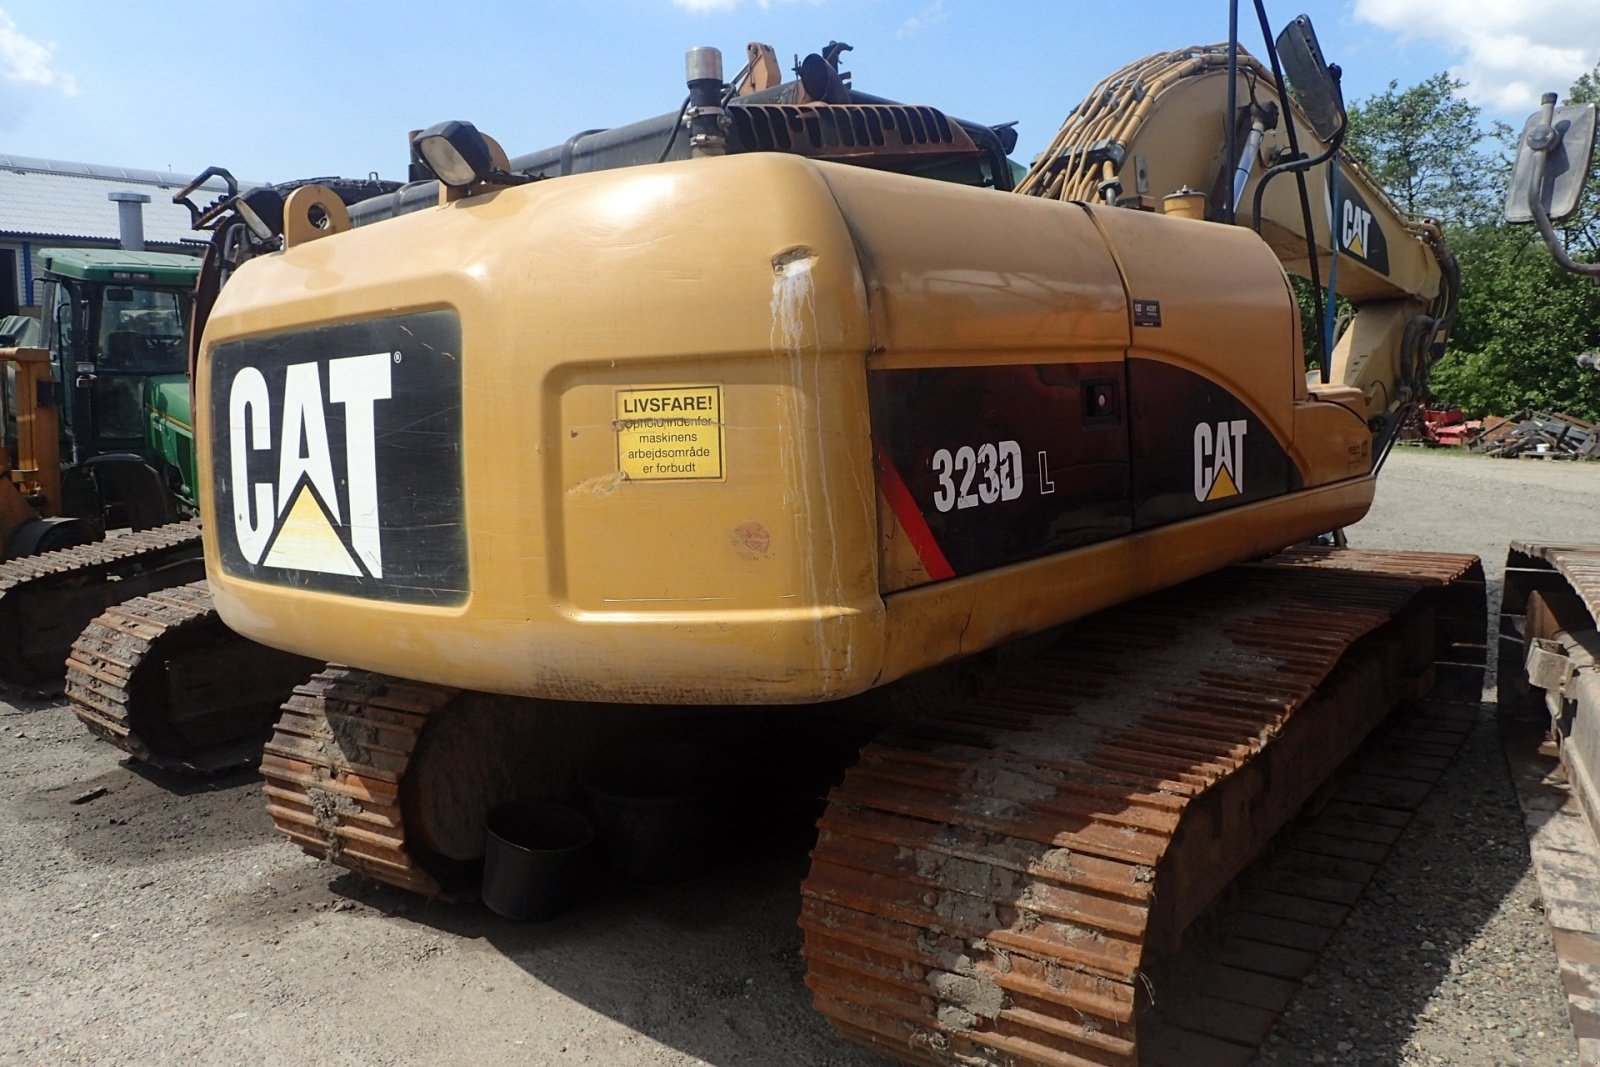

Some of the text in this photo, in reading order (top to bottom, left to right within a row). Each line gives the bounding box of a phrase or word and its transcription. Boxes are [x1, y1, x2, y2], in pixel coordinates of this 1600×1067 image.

[1342, 199, 1372, 260] CAT
[624, 395, 712, 413] LIVSFARE!
[628, 446, 710, 461] arbejdsområde
[639, 432, 698, 444] maskinens
[229, 352, 392, 579] CAT
[642, 462, 696, 474] er forbudt
[932, 440, 1055, 512] 323D L
[1194, 419, 1247, 502] CAT
